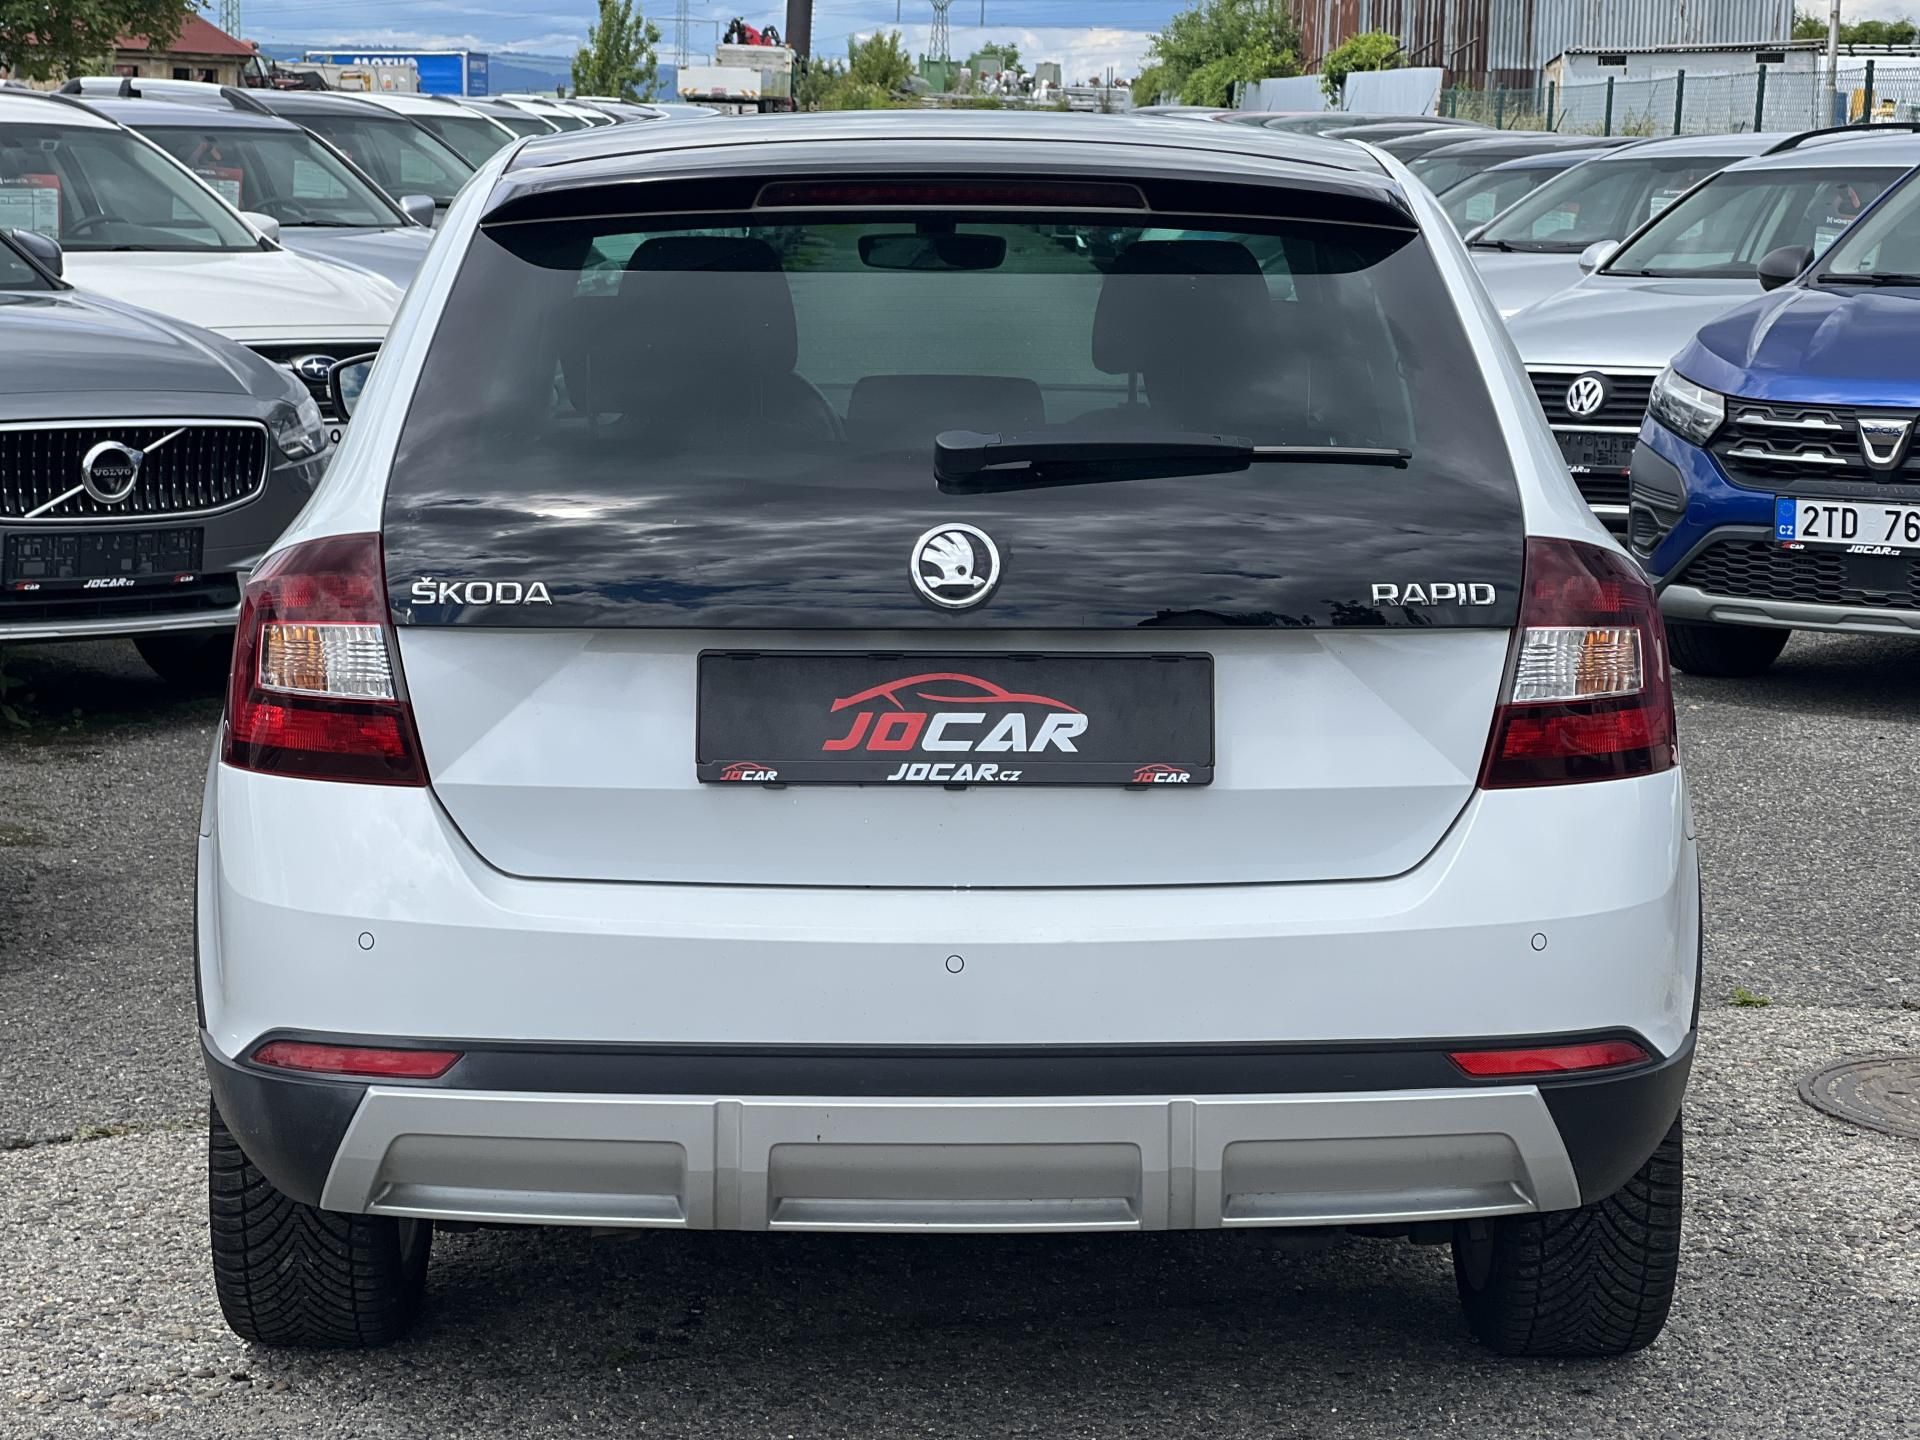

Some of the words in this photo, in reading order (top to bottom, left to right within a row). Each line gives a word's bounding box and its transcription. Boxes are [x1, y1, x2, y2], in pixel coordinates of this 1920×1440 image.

[93, 468, 132, 476] VOLVO
[1779, 525, 1794, 535] CZ
[1802, 506, 1858, 539] 2TD
[1885, 510, 1920, 543] 76
[411, 576, 553, 605] ŠKODA
[1371, 583, 1496, 606] RAPID
[822, 712, 1089, 752] JOCAR
[720, 770, 778, 780] JOCAR
[1132, 772, 1191, 783] JOCAR
